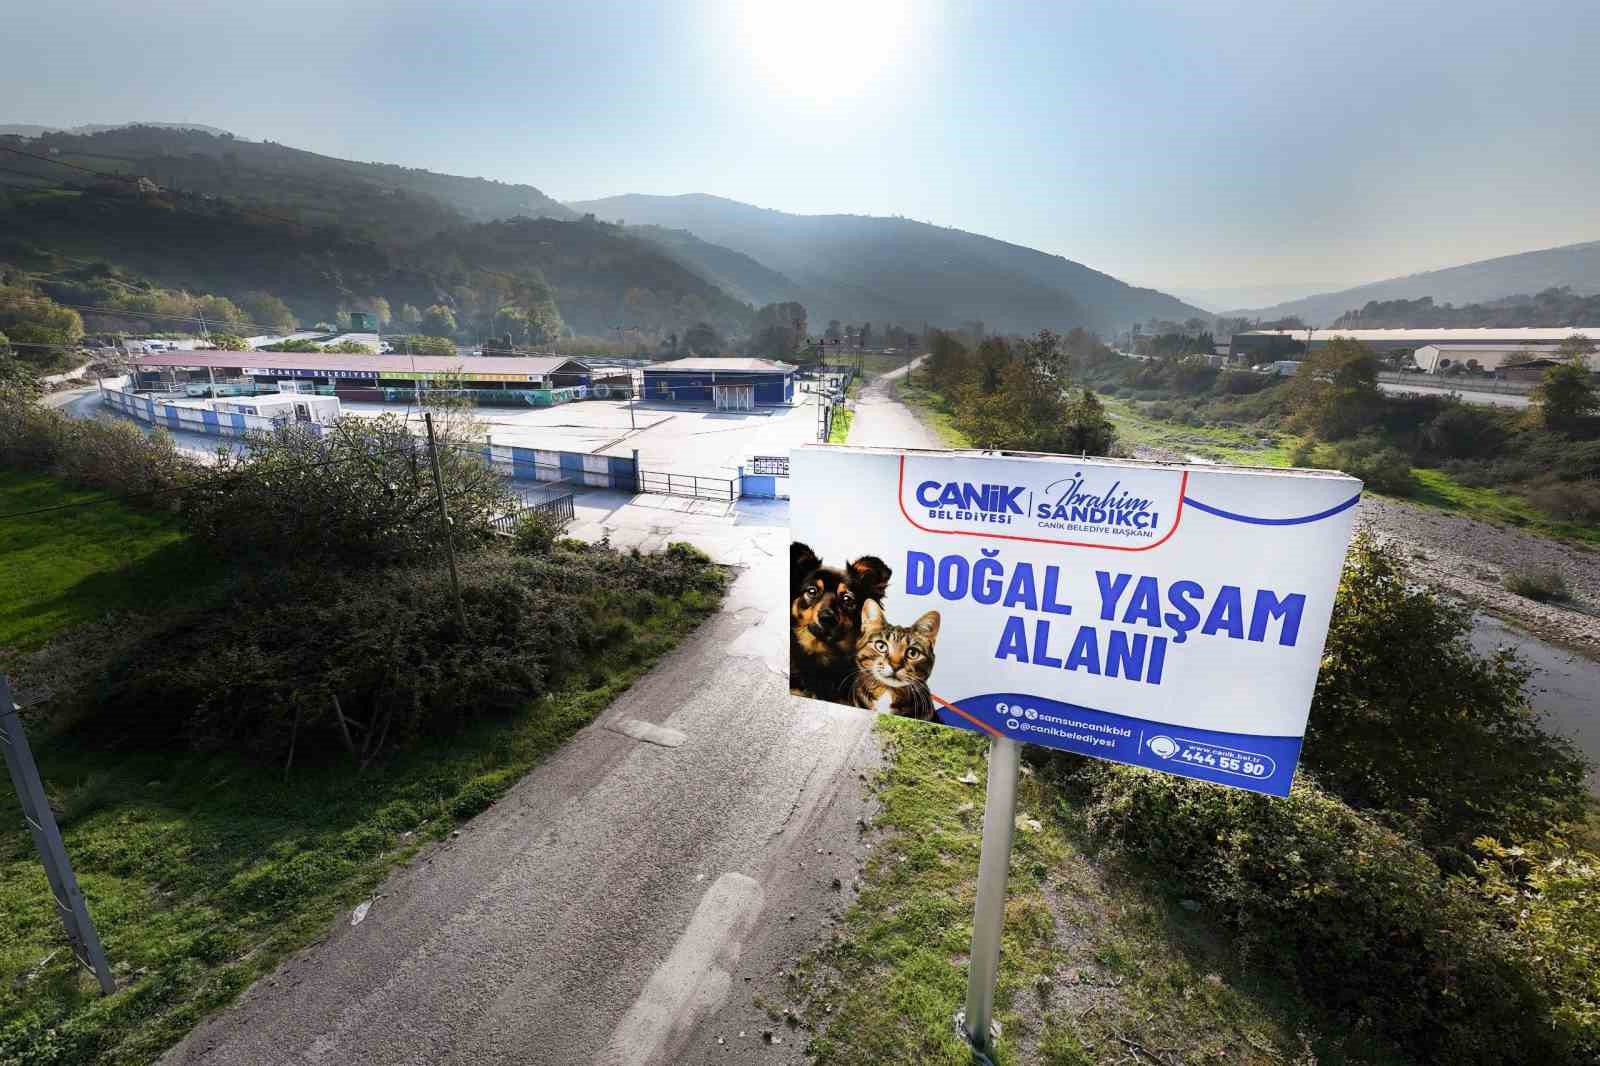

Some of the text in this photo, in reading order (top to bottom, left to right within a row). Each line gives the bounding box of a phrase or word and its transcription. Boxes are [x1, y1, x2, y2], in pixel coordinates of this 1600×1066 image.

[1037, 503, 1159, 529] SANDIKÇI
[906, 548, 1306, 648] DOĞAL YAŞAM
[995, 616, 1168, 686] ALANI
[1020, 722, 1115, 748] @canikbelediyesi
[1039, 713, 1131, 737] samsuncanikbld
[1181, 750, 1265, 776] 444 55 90
